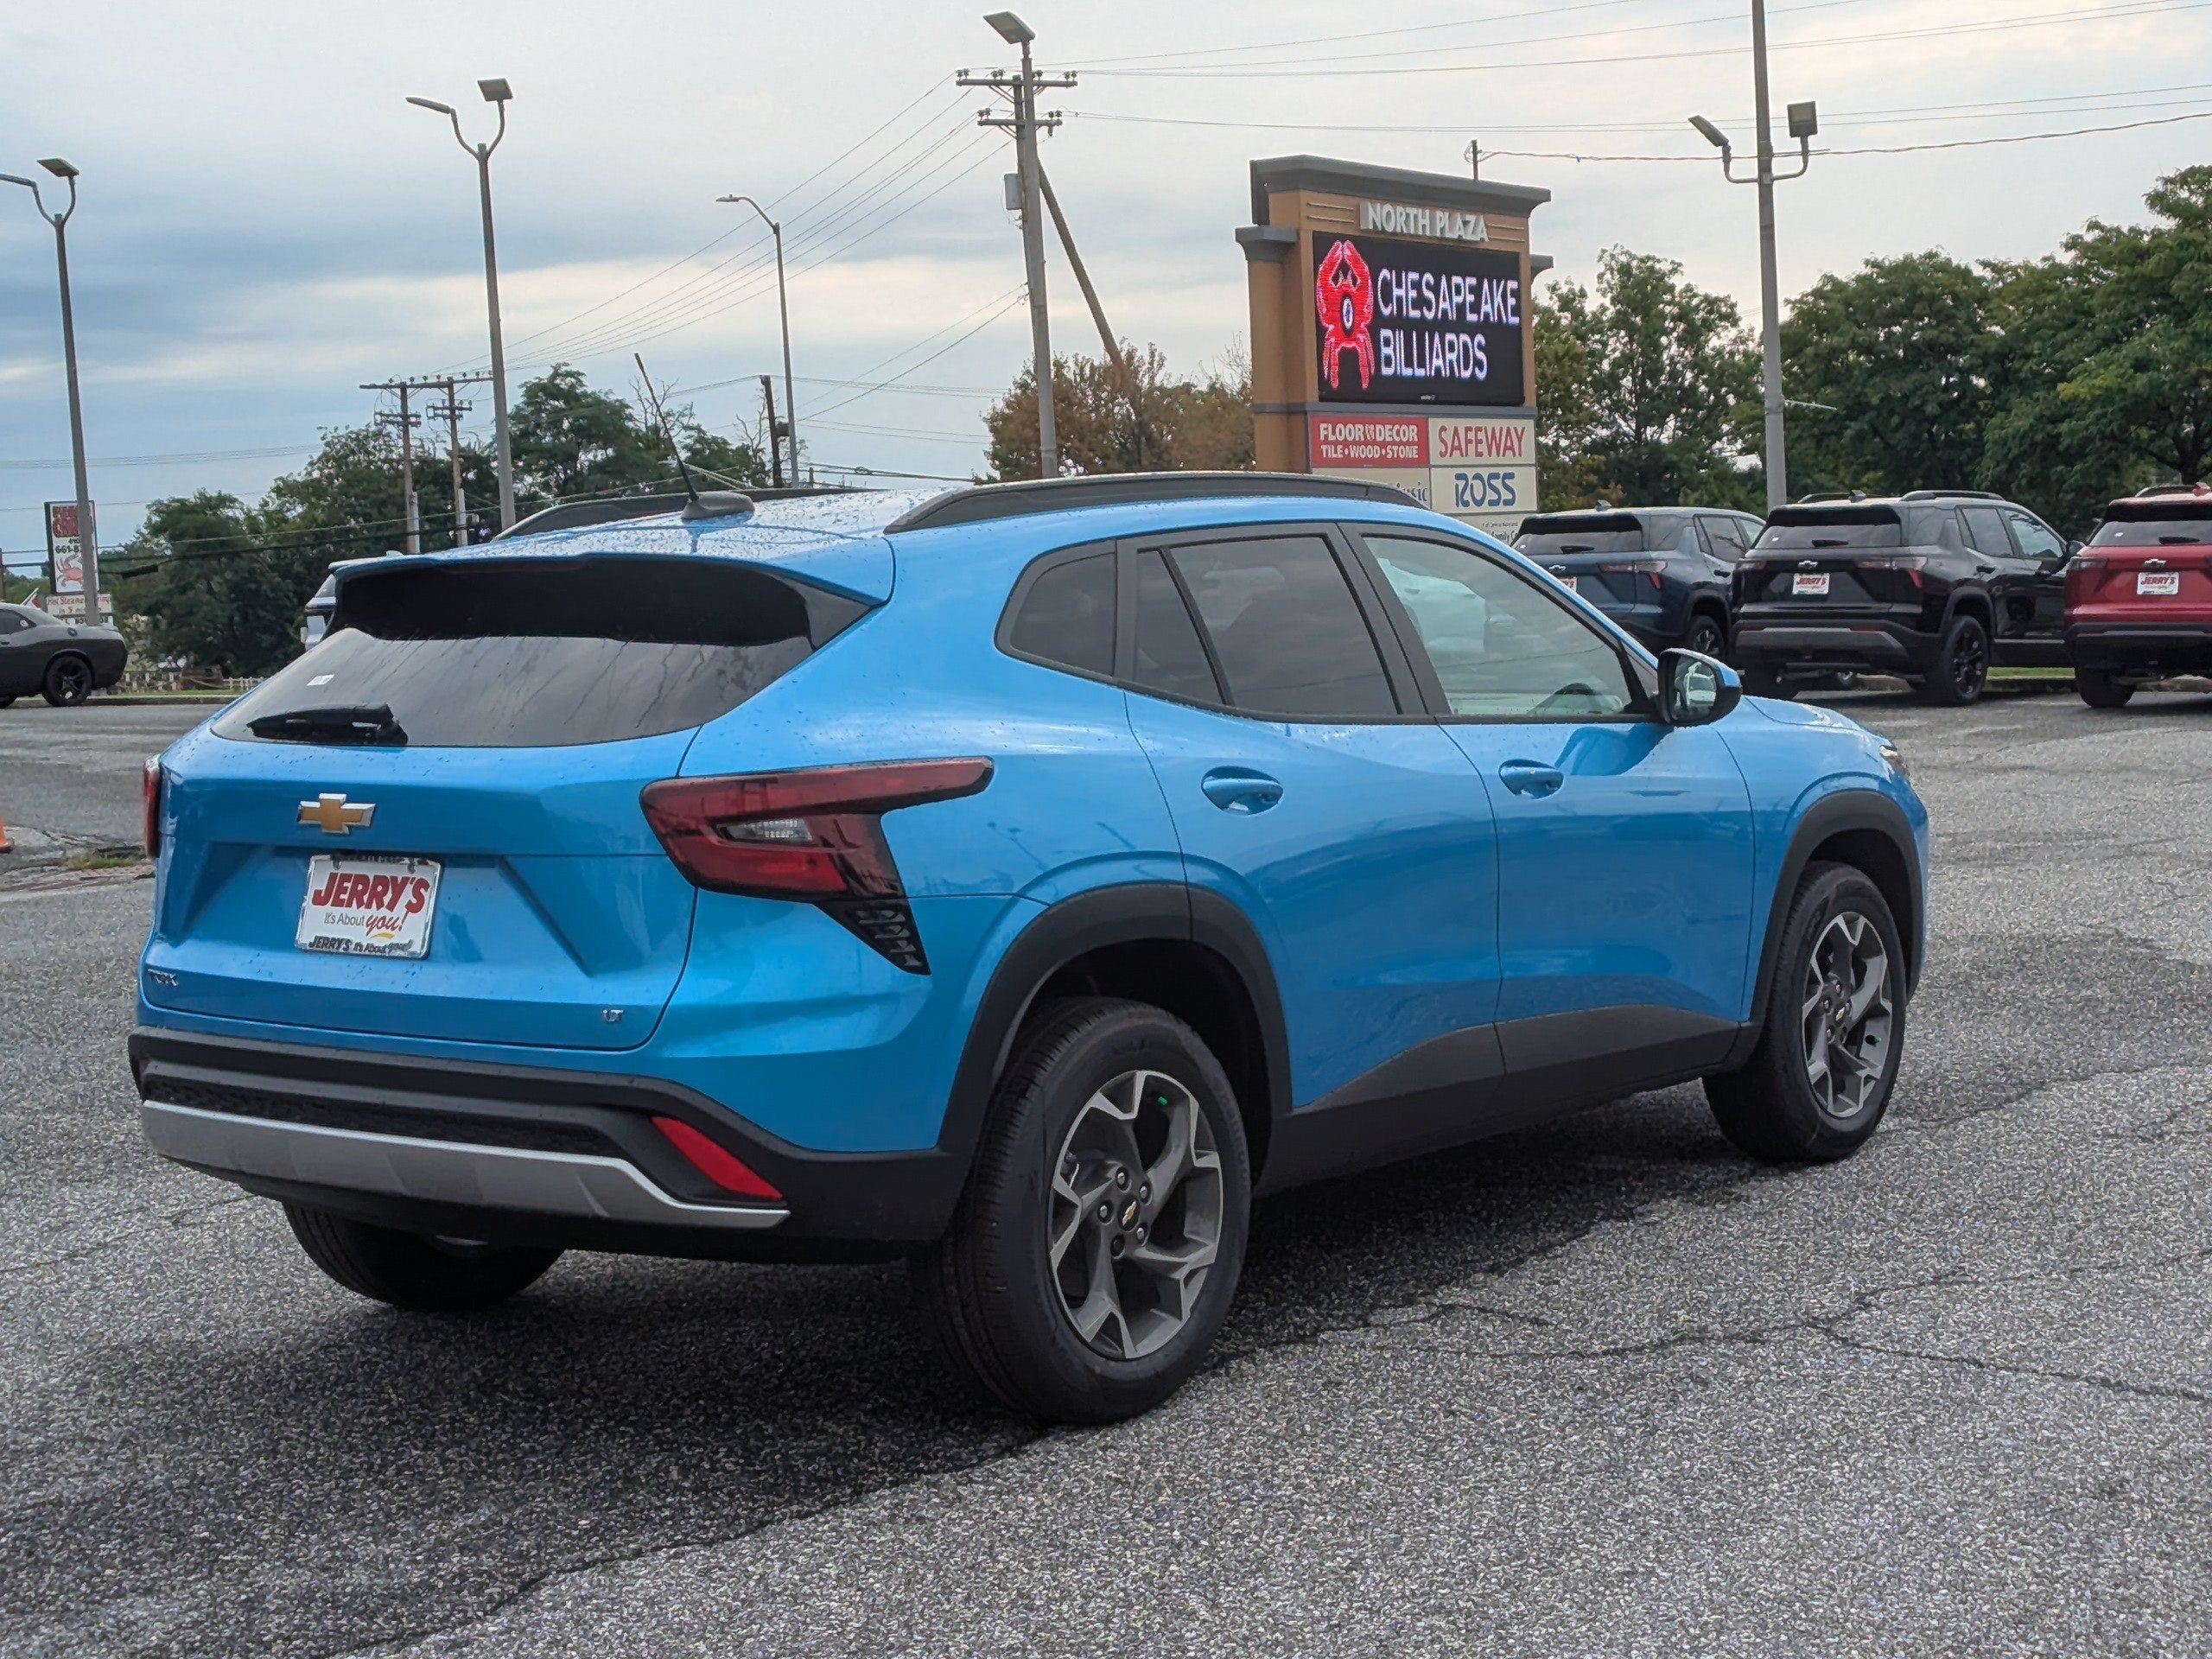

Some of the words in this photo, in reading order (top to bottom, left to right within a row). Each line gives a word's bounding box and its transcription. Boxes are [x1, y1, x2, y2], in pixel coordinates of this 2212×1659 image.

[1364, 201, 1430, 236] NORTH
[1435, 213, 1490, 242] PLAZA
[1377, 268, 1520, 326] CHESAPEAKE
[1379, 328, 1488, 380] BILLIARDS
[1319, 423, 1364, 442] FLOOR
[1376, 424, 1418, 442] DECOR
[1438, 425, 1526, 458] SAFEWAY
[1320, 444, 1344, 458] TILE
[1349, 445, 1381, 459] WOOD
[1386, 445, 1419, 459] STONE
[1454, 472, 1516, 508] ROSS
[311, 872, 430, 914] JERRY'S
[324, 912, 335, 924] It's
[337, 912, 365, 926] About
[365, 910, 410, 937] you!
[308, 935, 353, 951] JERRY'S
